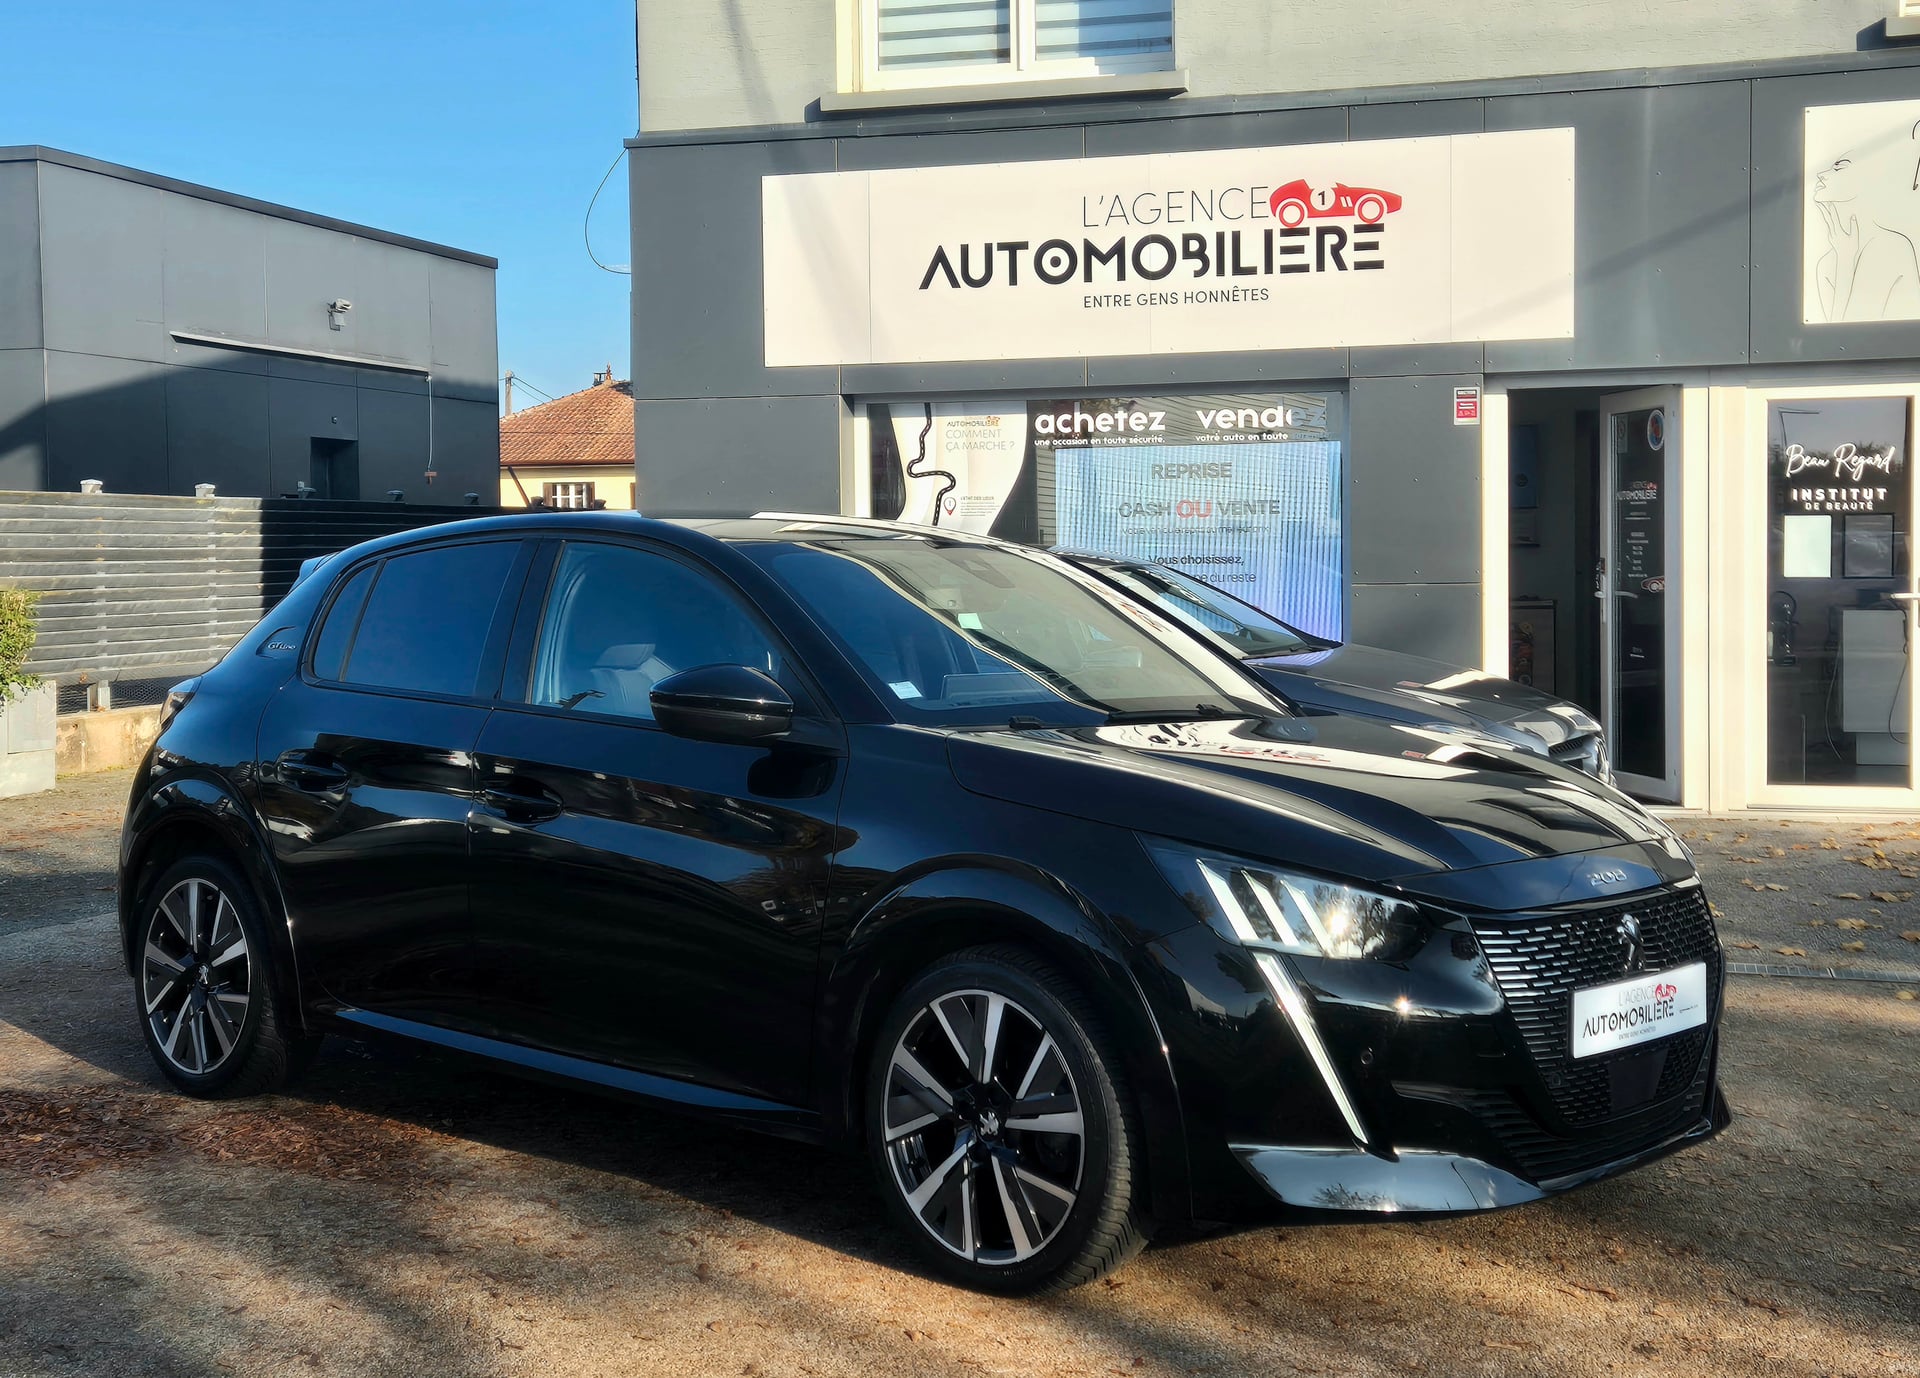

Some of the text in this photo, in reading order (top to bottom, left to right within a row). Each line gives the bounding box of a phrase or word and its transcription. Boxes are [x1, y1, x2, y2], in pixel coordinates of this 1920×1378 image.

[1083, 186, 1269, 228] L'AGENCE
[1083, 286, 1270, 308] ENTRE GENS HONNÊTES
[1035, 402, 1166, 434] achetez
[945, 429, 1002, 439] COMMENT
[1195, 433, 1220, 442] votre
[1222, 433, 1245, 441] auto
[1247, 433, 1260, 441] en
[1262, 432, 1289, 441] toute
[945, 441, 960, 453] ÇA
[962, 440, 1007, 450] MARCHE
[1052, 438, 1089, 446] occasion
[1103, 436, 1127, 444] toute
[1785, 442, 1896, 481] Beau Regard
[1151, 462, 1233, 480] REPRISE
[1791, 488, 1888, 501] INSTITUT
[1118, 499, 1281, 518] CASH OU VENTE
[1805, 500, 1874, 511] DE BEAUTÉ
[1148, 555, 1178, 565] Vous
[1210, 572, 1225, 583] du
[1227, 573, 1257, 583] reste
